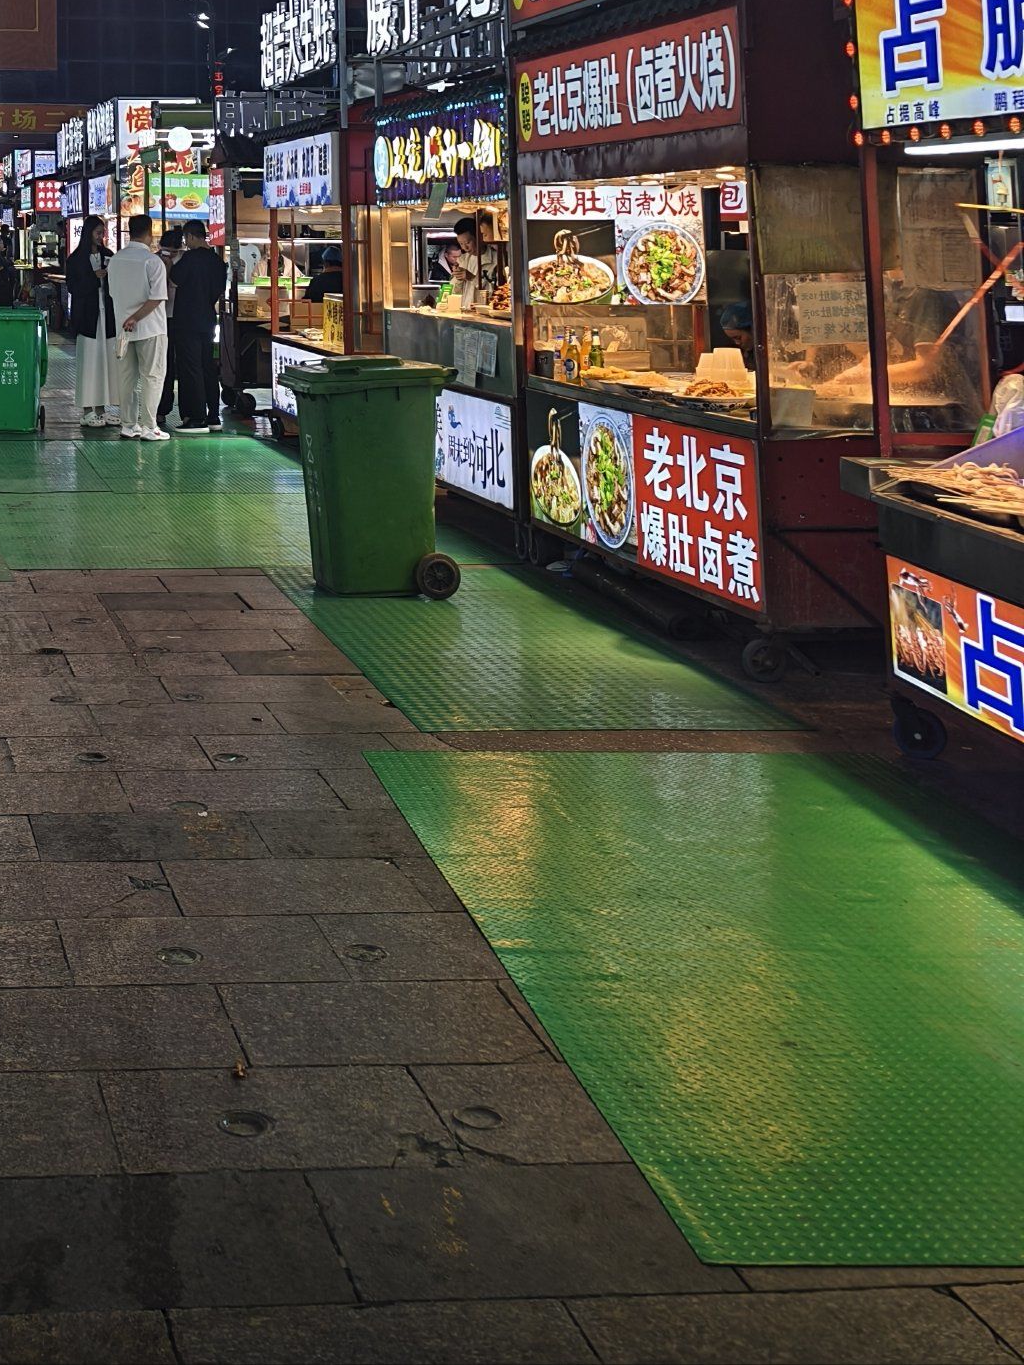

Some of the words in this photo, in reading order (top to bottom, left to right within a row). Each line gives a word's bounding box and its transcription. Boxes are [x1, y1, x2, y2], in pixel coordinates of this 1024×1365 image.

[886, 100, 941, 124] 占据高峰
[533, 188, 607, 217] 爆肚
[615, 188, 700, 217] 卤煮火烧
[721, 183, 745, 211] 包
[643, 426, 748, 522] 老北京
[640, 501, 761, 604] 爆肚卤煮
